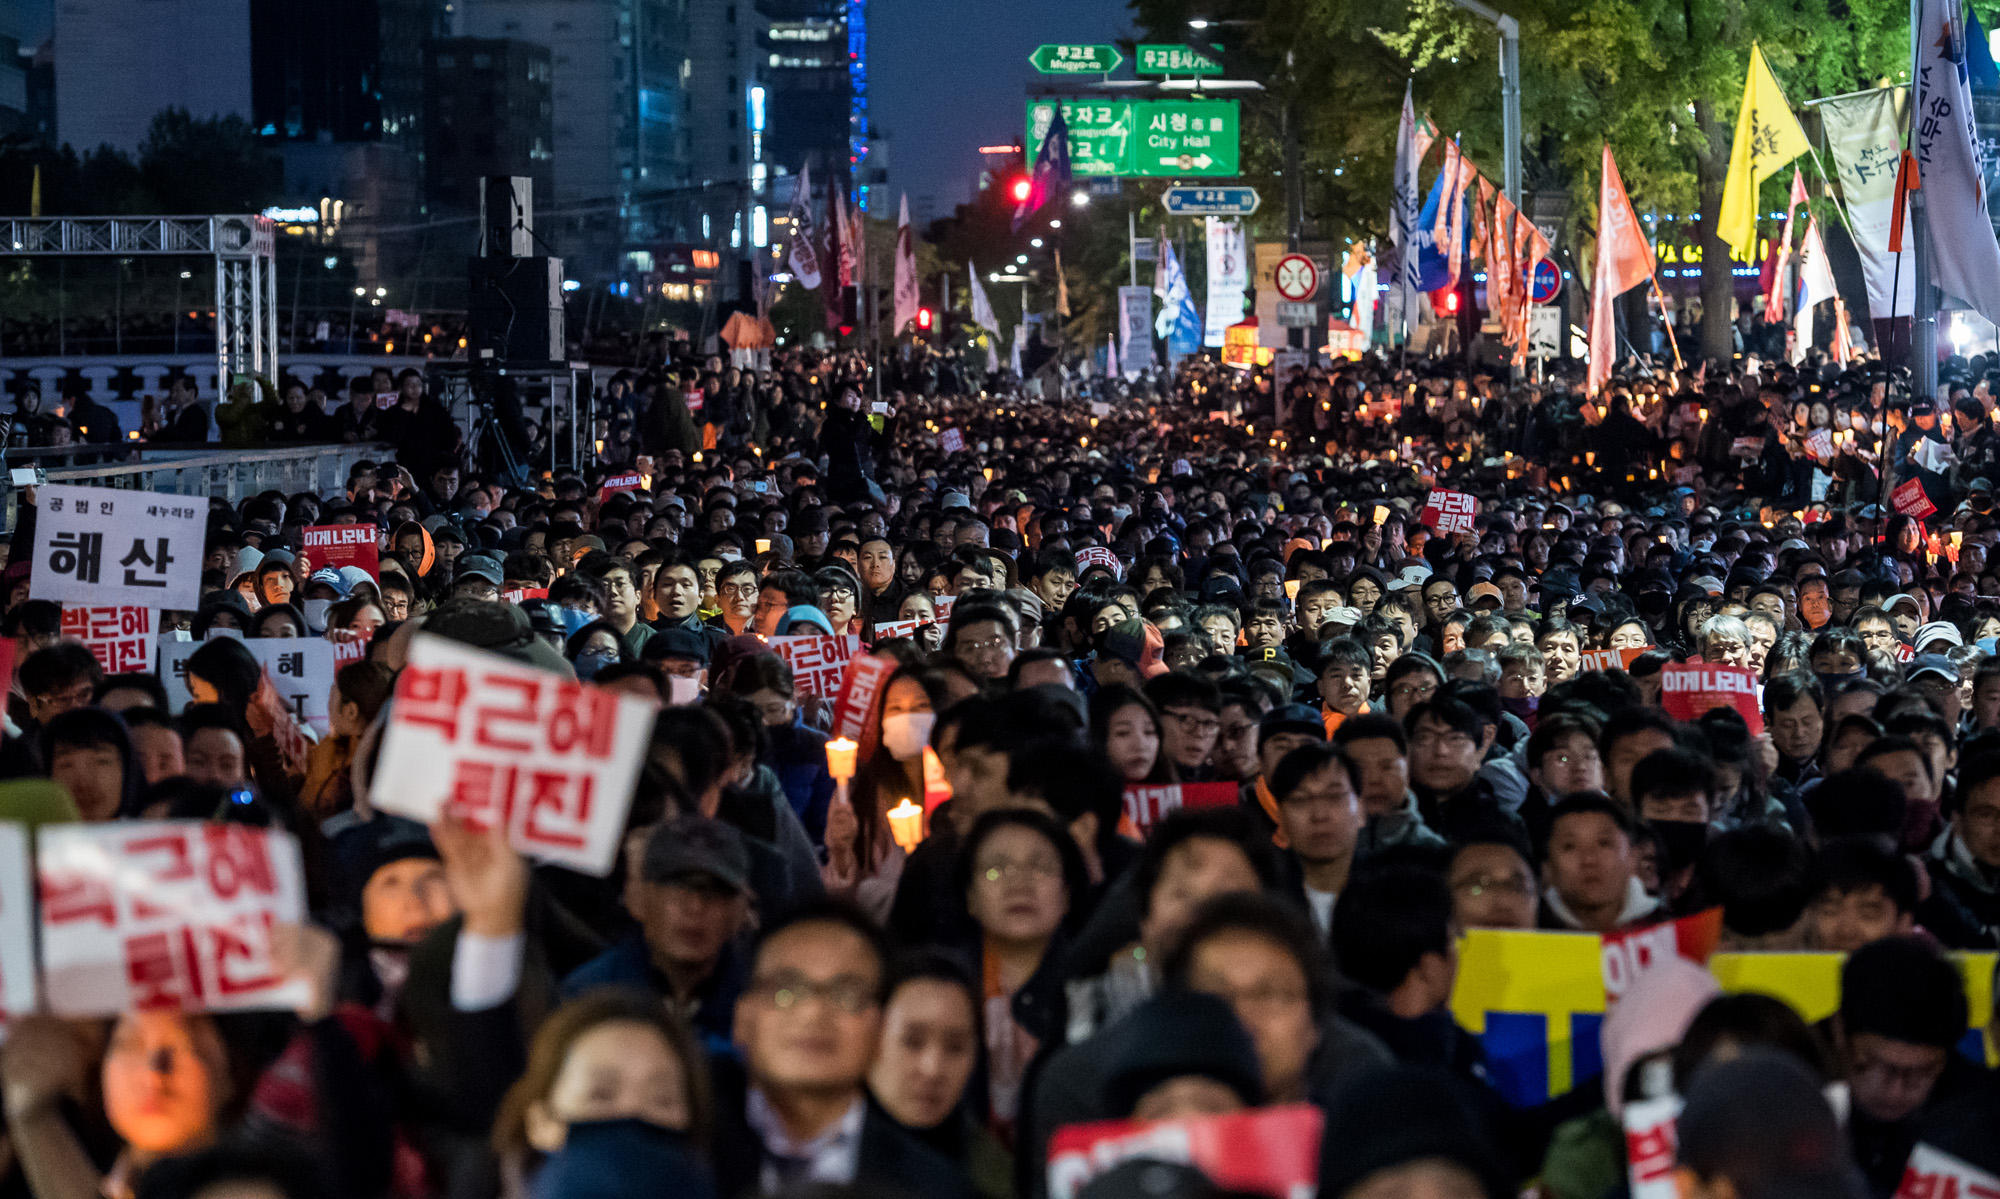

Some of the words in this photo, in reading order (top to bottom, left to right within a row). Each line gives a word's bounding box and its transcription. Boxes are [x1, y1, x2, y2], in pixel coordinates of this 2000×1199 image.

[1057, 46, 1095, 60] 무교로
[1149, 112, 1187, 132] 시청
[1148, 135, 1177, 150] City
[1183, 135, 1211, 148] Hall
[1427, 491, 1475, 514] 박근혜
[1436, 512, 1472, 533] 퇴진
[61, 606, 149, 640] 박근혜
[88, 638, 147, 673] 퇴진
[1264, 648, 1276, 661] P
[397, 664, 619, 761] 박근혜
[453, 759, 595, 850] 퇴진
